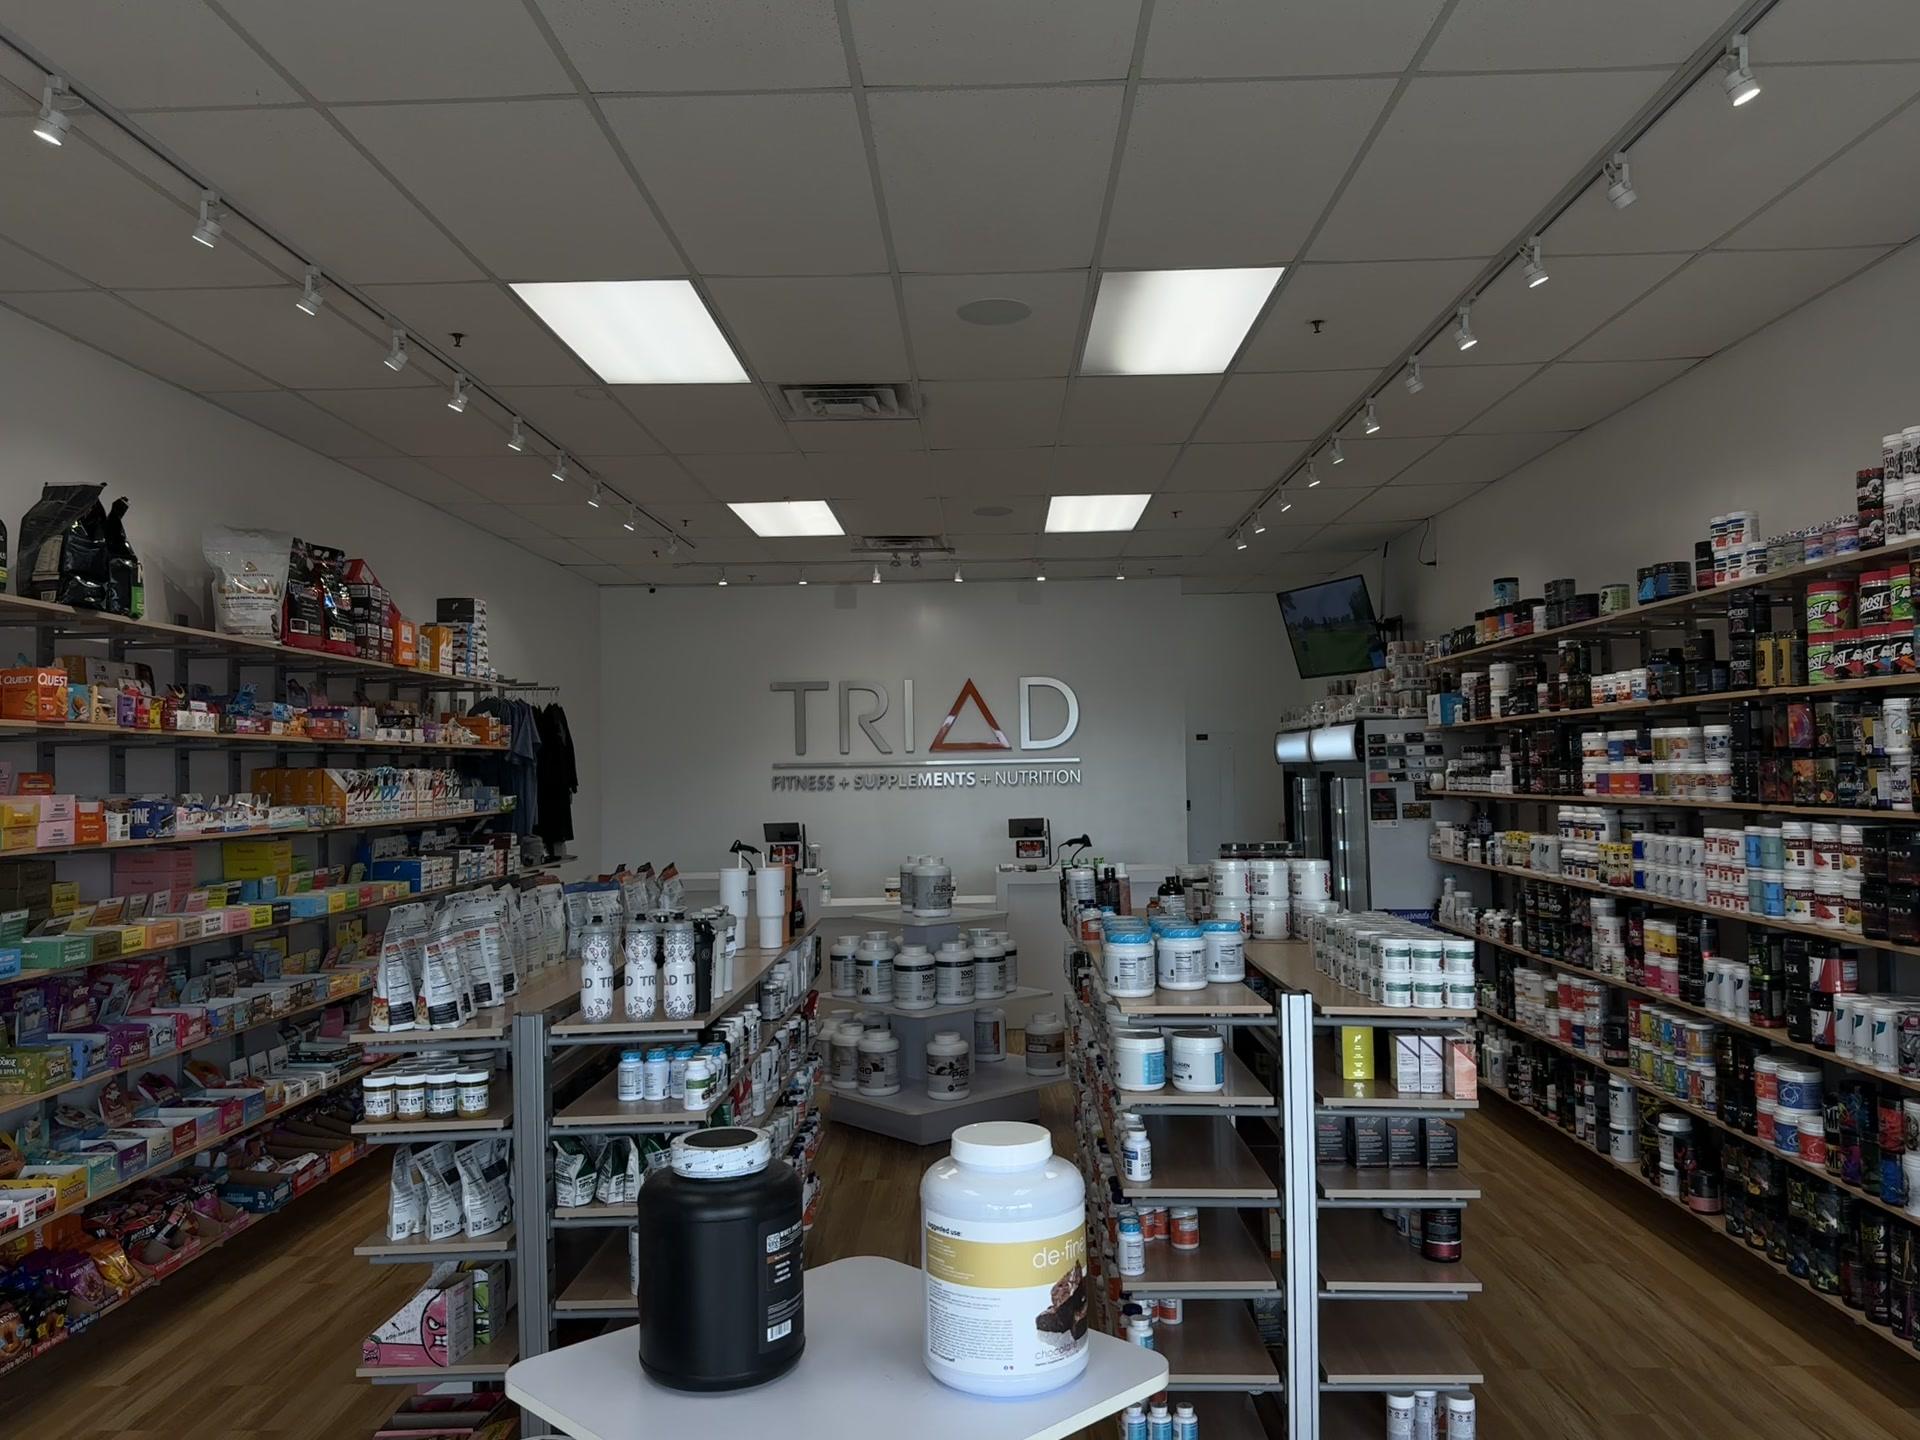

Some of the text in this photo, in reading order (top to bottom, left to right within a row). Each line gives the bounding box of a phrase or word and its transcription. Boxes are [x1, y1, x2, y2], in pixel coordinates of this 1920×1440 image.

[3, 675, 33, 685] QUEST
[37, 672, 68, 687] QUEST
[770, 676, 1080, 755] TRIAD
[772, 775, 835, 791] FITNESS
[854, 771, 976, 791] SUPPLEMENTS
[995, 769, 1081, 786] NUTRITION
